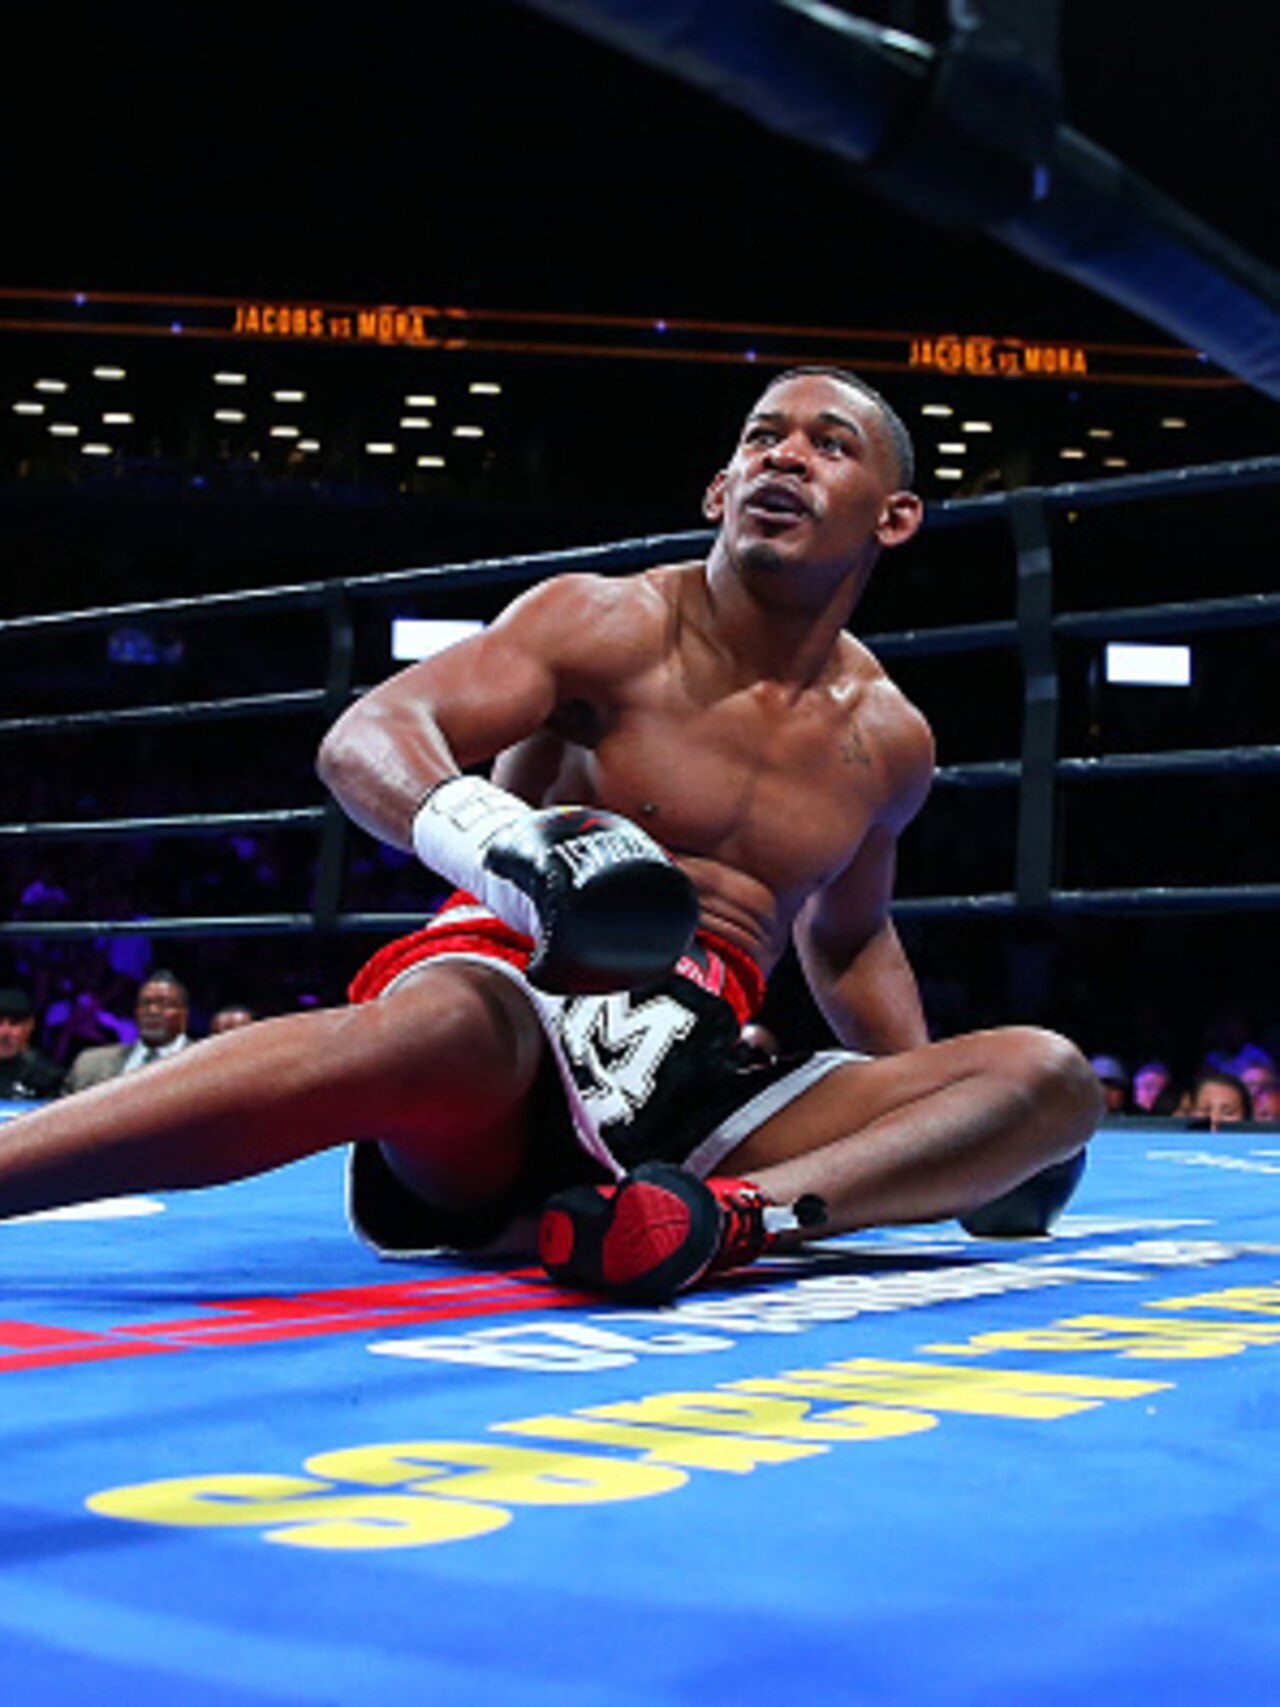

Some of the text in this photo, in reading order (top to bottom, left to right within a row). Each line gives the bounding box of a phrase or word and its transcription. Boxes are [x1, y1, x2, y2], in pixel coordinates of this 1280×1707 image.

[233, 305, 325, 335] JACOBS
[357, 310, 426, 341] MORA
[1023, 346, 1088, 377] MORA
[84, 1358, 1176, 1551] Mares
